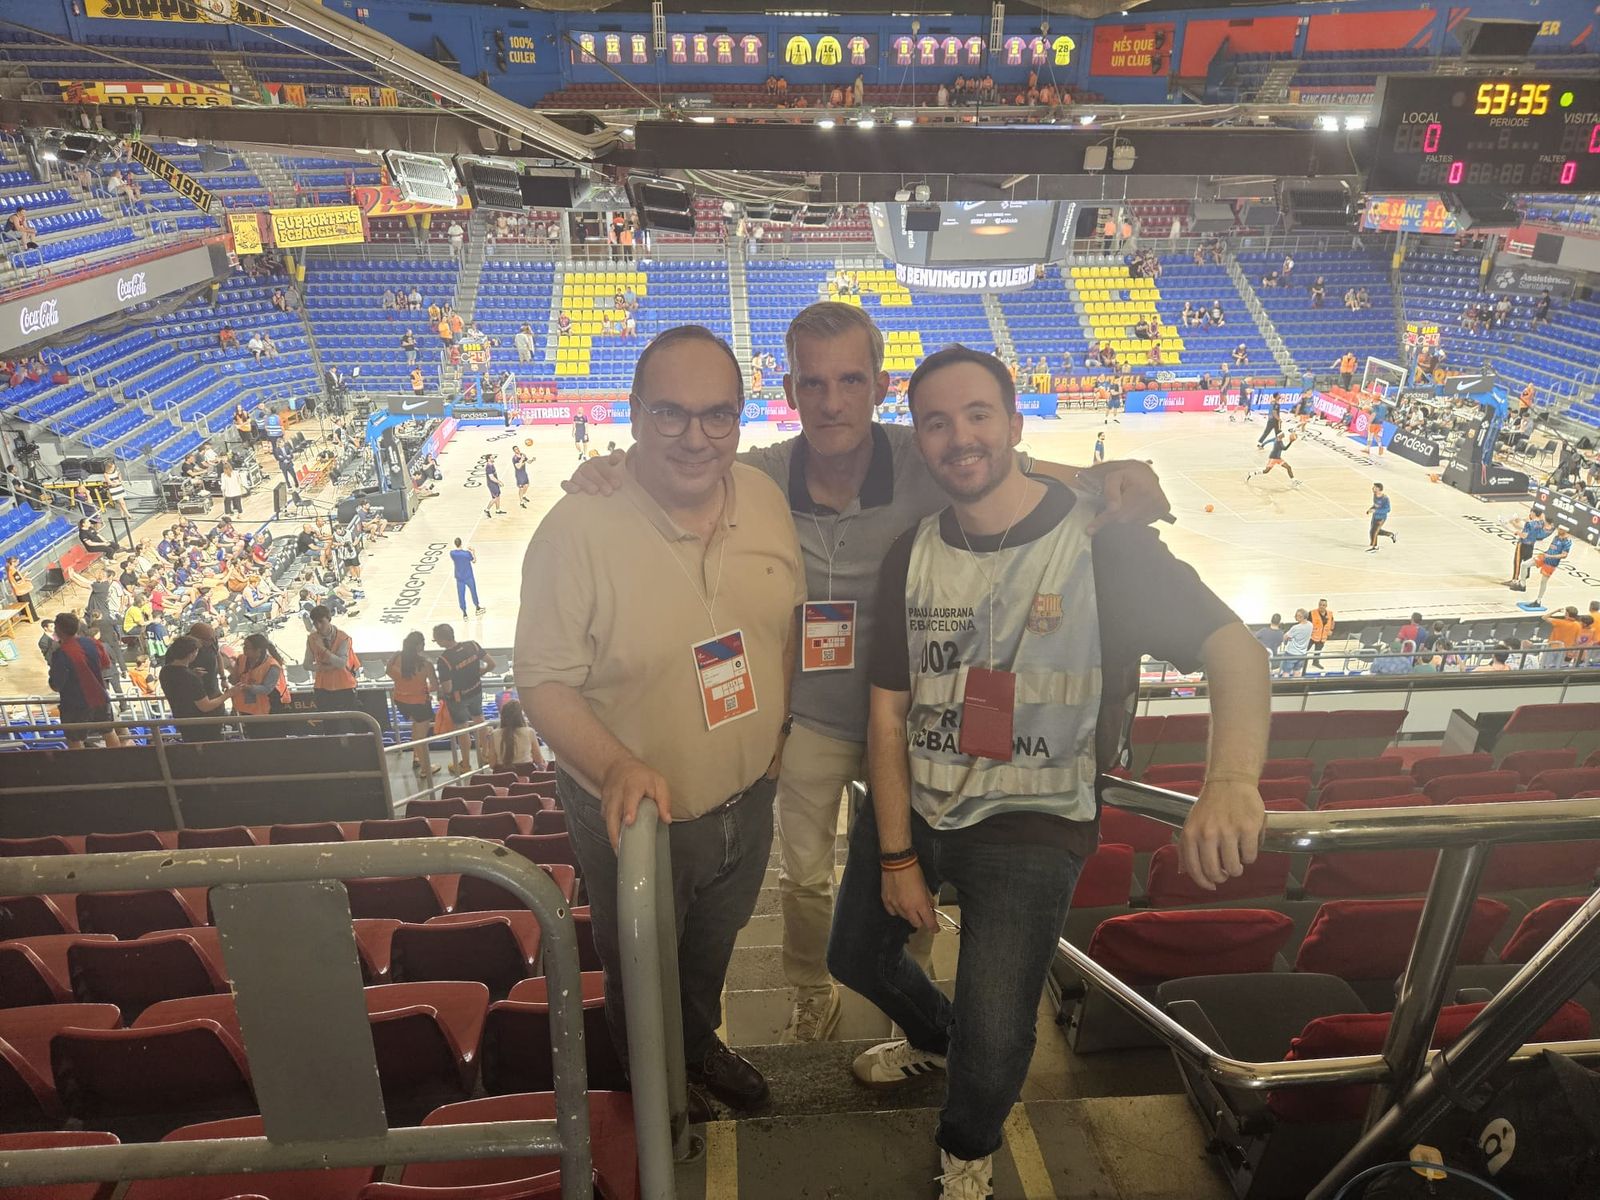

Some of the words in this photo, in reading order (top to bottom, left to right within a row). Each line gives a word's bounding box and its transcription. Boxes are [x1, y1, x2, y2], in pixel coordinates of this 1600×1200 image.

[509, 36, 534, 49] 100%
[719, 41, 729, 52] 21
[796, 44, 800, 53] 1
[823, 44, 833, 53] 16
[1058, 44, 1069, 53] 28
[1112, 36, 1132, 52] MÉS
[1133, 39, 1155, 51] QUE
[508, 51, 536, 64] CULER
[1111, 55, 1125, 67] UN
[1126, 54, 1151, 66] CLUB
[1474, 83, 1551, 116] 53:35
[1402, 112, 1441, 124] LOCAL
[1489, 117, 1530, 127] PERIODE
[1423, 124, 1442, 153] 0
[1425, 154, 1453, 163] FALTES
[1539, 154, 1567, 163] FALTES
[1448, 161, 1463, 184] 0
[1560, 161, 1576, 184] 0
[176, 172, 211, 209] 1991
[1391, 203, 1422, 218] SANG
[276, 210, 359, 231] SUPPORTERS
[906, 267, 988, 289] BENVINGUTS
[988, 265, 1030, 288] CULERS
[1393, 433, 1434, 457] endesa
[379, 542, 448, 624] #ligaendesa
